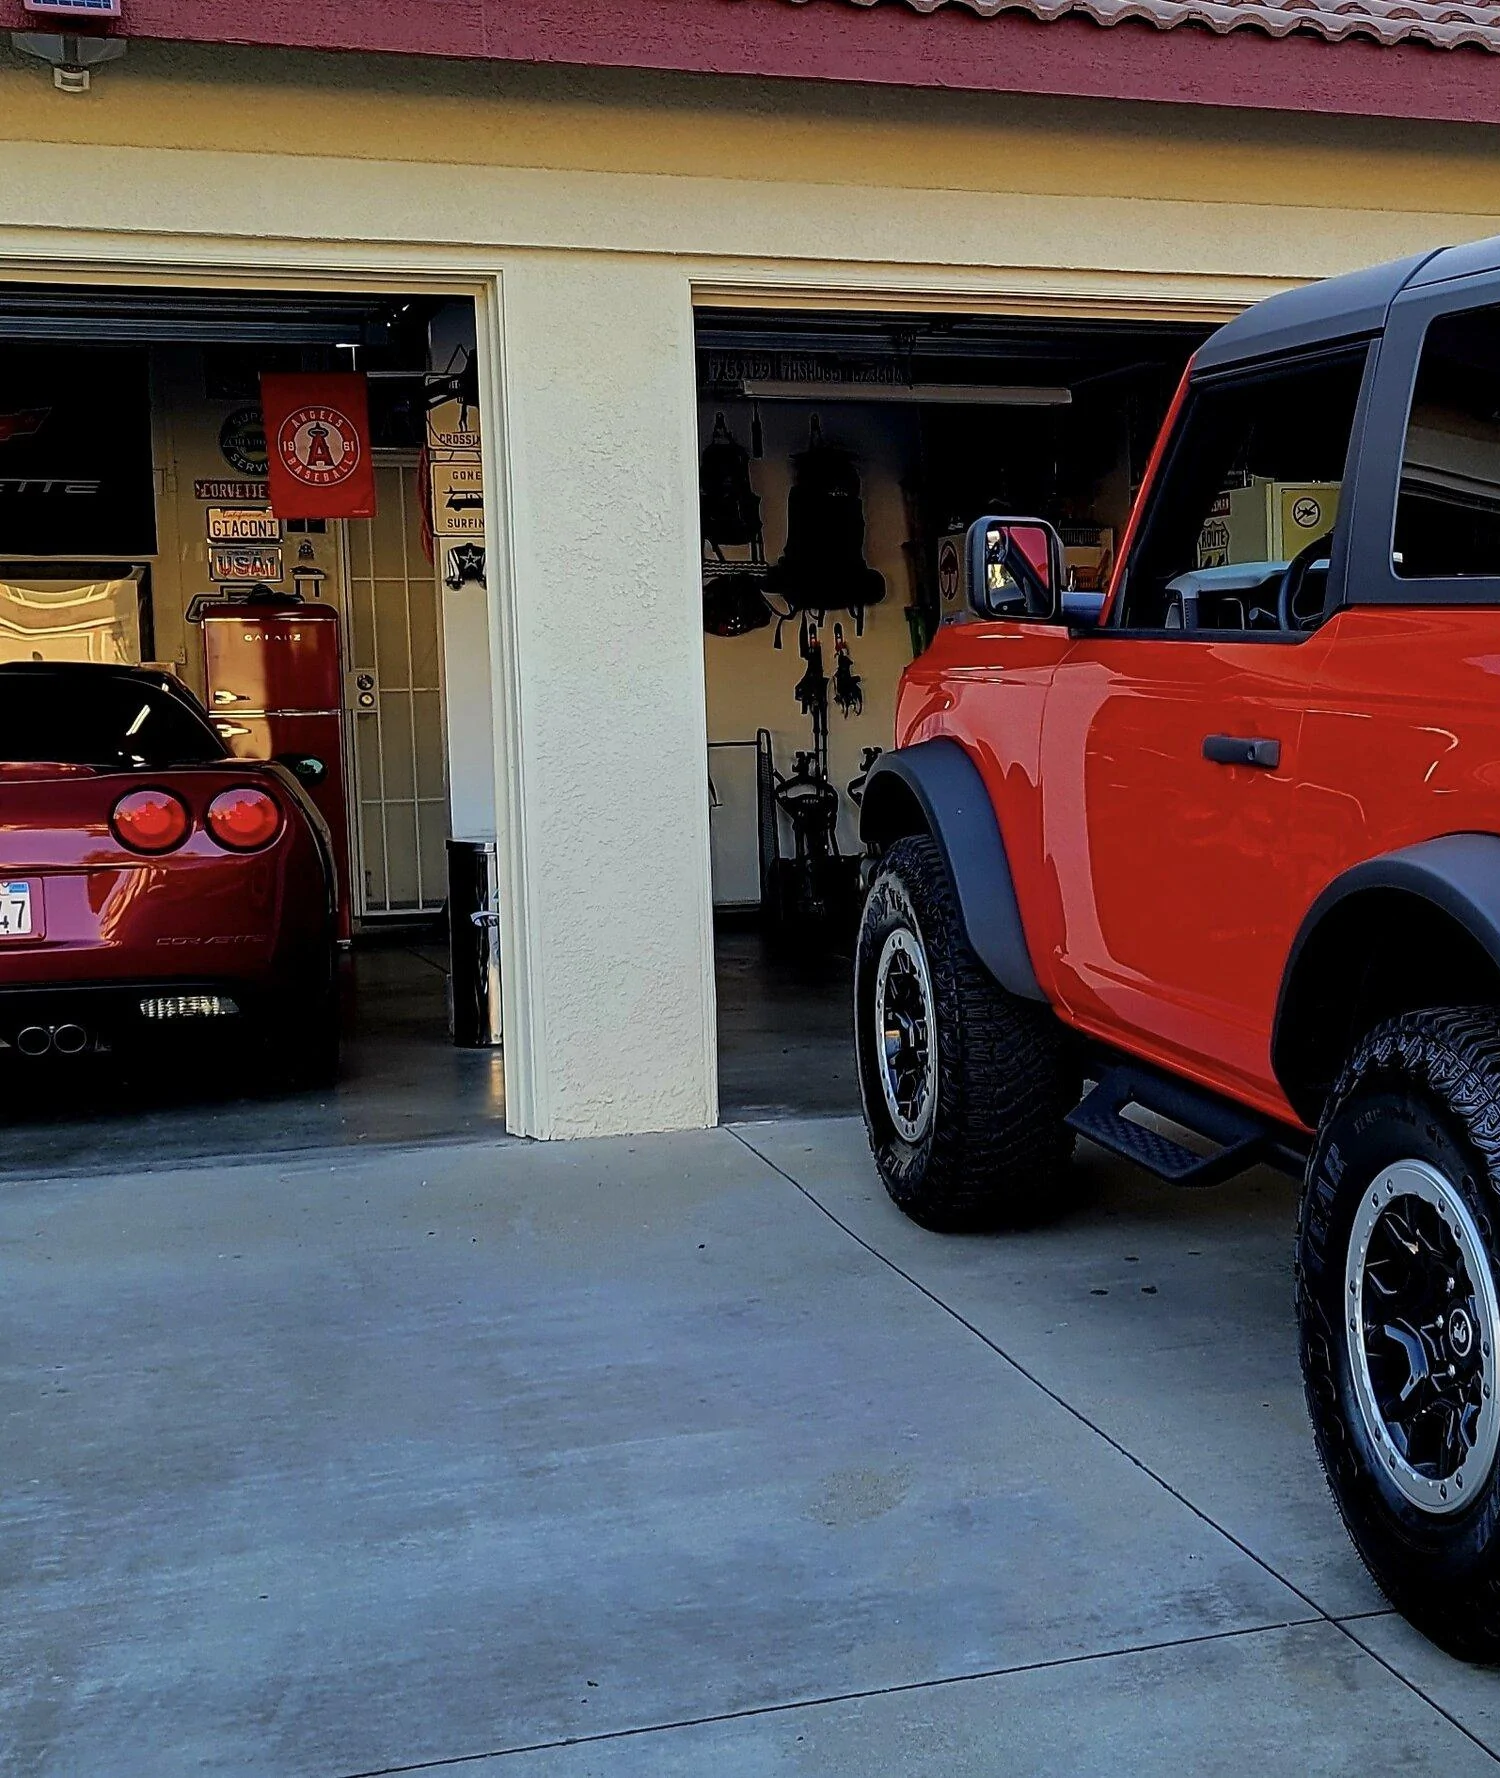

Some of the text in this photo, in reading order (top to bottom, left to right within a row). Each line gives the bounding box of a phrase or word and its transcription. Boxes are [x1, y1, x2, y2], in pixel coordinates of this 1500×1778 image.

[291, 409, 345, 429] ANGELS
[282, 440, 295, 453] 19
[342, 440, 355, 453] 61
[230, 453, 269, 473] SERVI
[286, 456, 356, 483] BASEBALL
[452, 471, 482, 480] GONE
[0, 478, 103, 495] TTE
[202, 483, 268, 499] CORVETTE
[213, 520, 276, 537] GIACONI
[1201, 528, 1227, 549] ROUTE
[217, 556, 276, 578] USA1
